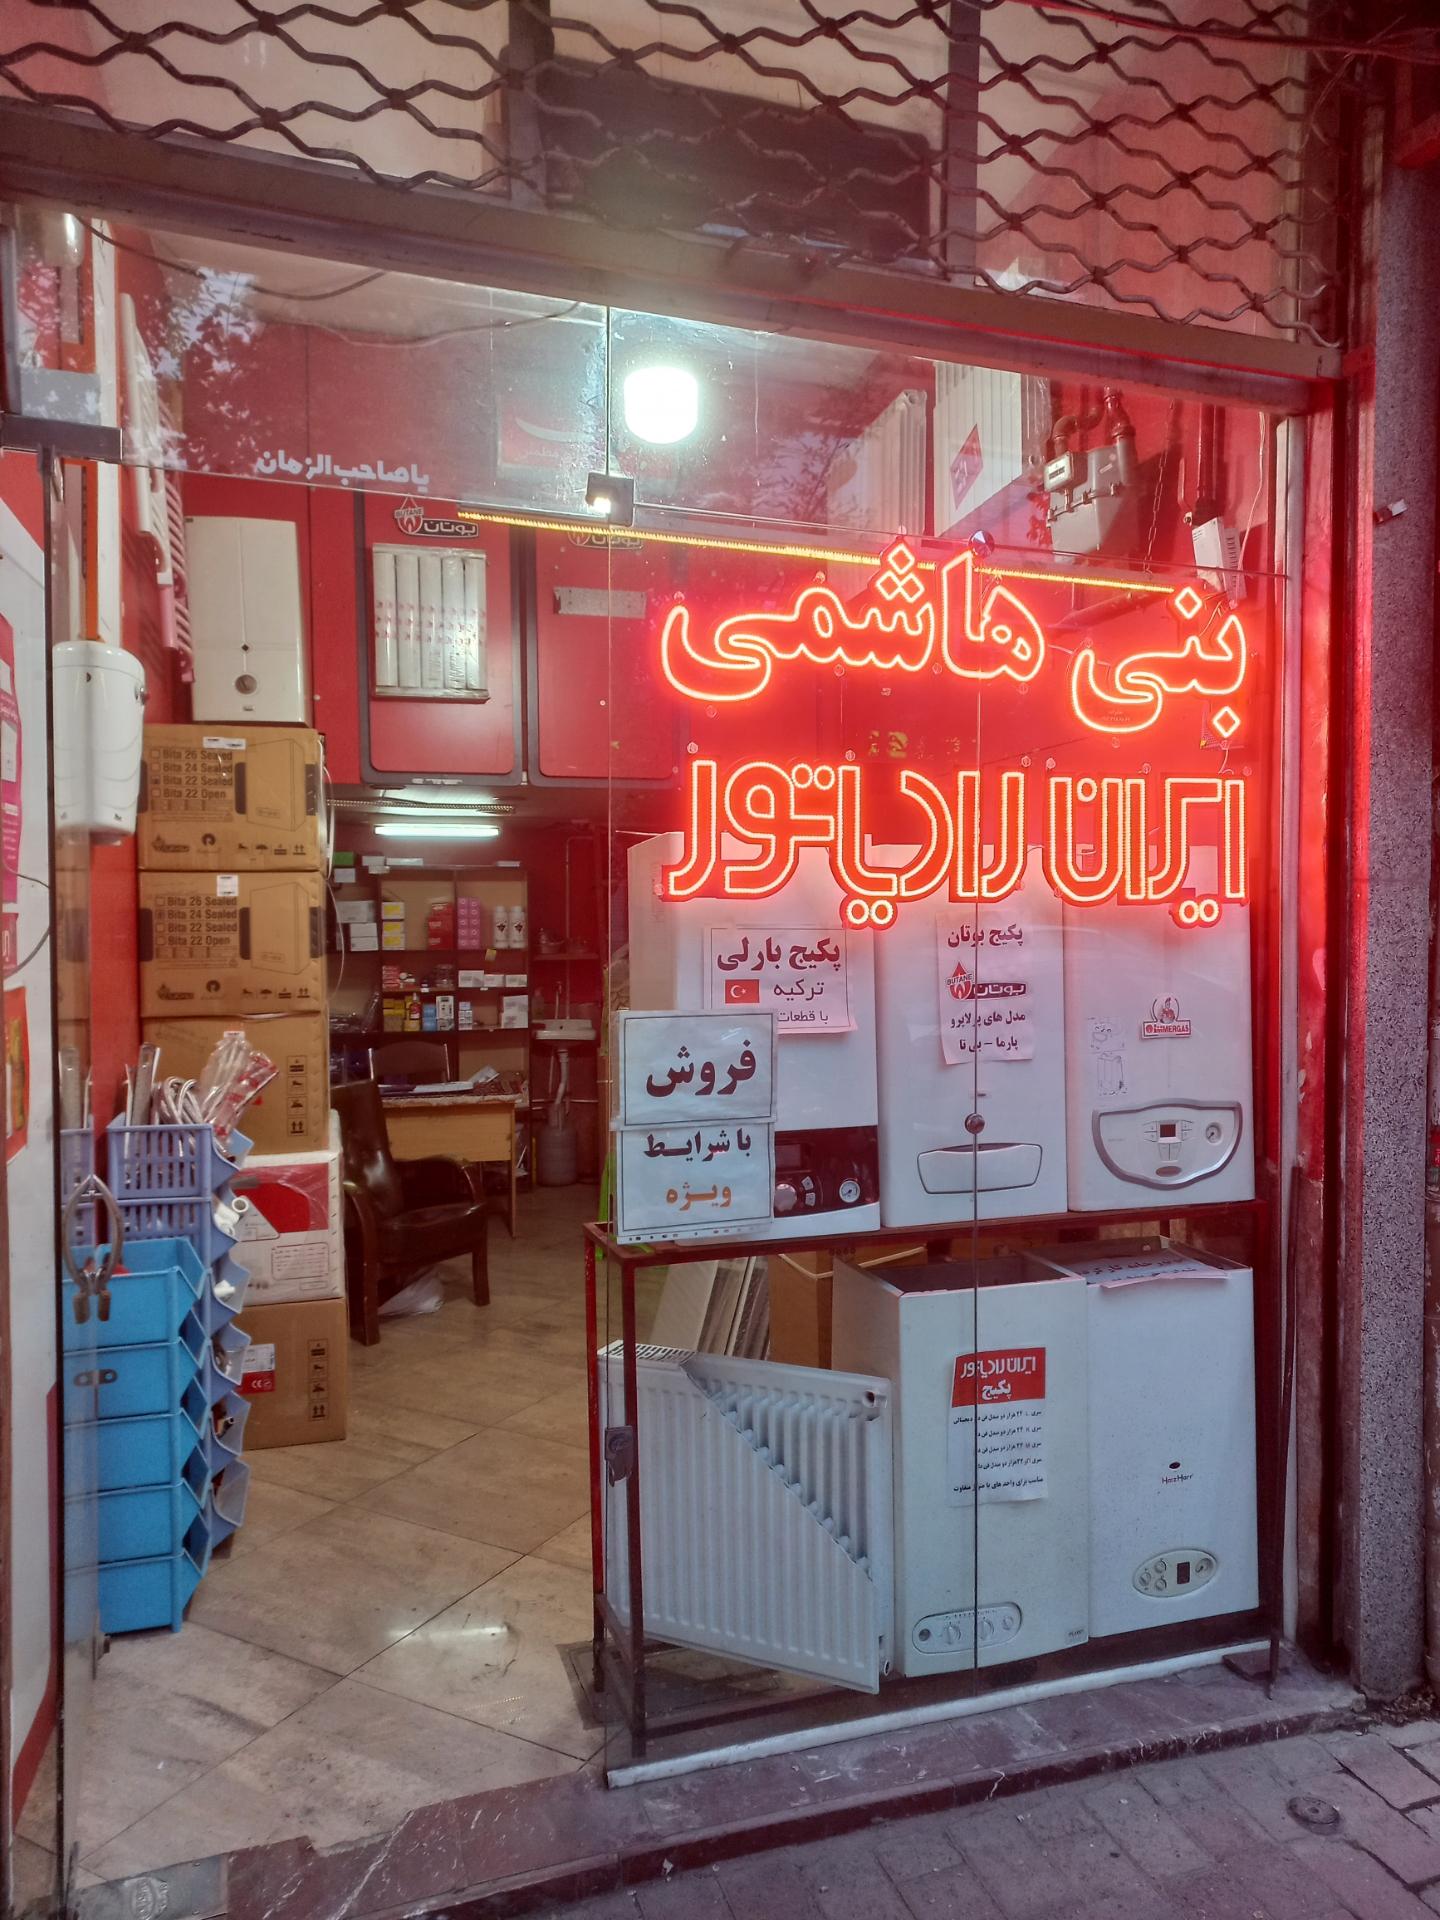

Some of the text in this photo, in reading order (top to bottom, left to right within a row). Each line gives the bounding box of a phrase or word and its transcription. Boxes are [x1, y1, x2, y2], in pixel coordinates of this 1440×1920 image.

[423, 519, 477, 537] بوتان
[659, 541, 1248, 740] بنی هاشمی
[664, 759, 1247, 927] ایران رادیاتور
[947, 923, 1024, 948] پکیج بوتان
[717, 936, 841, 972] پکیج بارلی
[773, 979, 825, 1001] ترکیه
[973, 982, 1026, 996] بوتان
[819, 1010, 829, 1025] با
[983, 1010, 1003, 1026] های
[1005, 1010, 1027, 1025] مدل
[996, 1036, 1019, 1051] پارما
[646, 1039, 757, 1098] فروش
[643, 1128, 752, 1163] با شرایط
[665, 1181, 732, 1212] ویژه
[960, 1355, 1037, 1379] ایران رادیاتور
[981, 1379, 1013, 1401] پکیج
